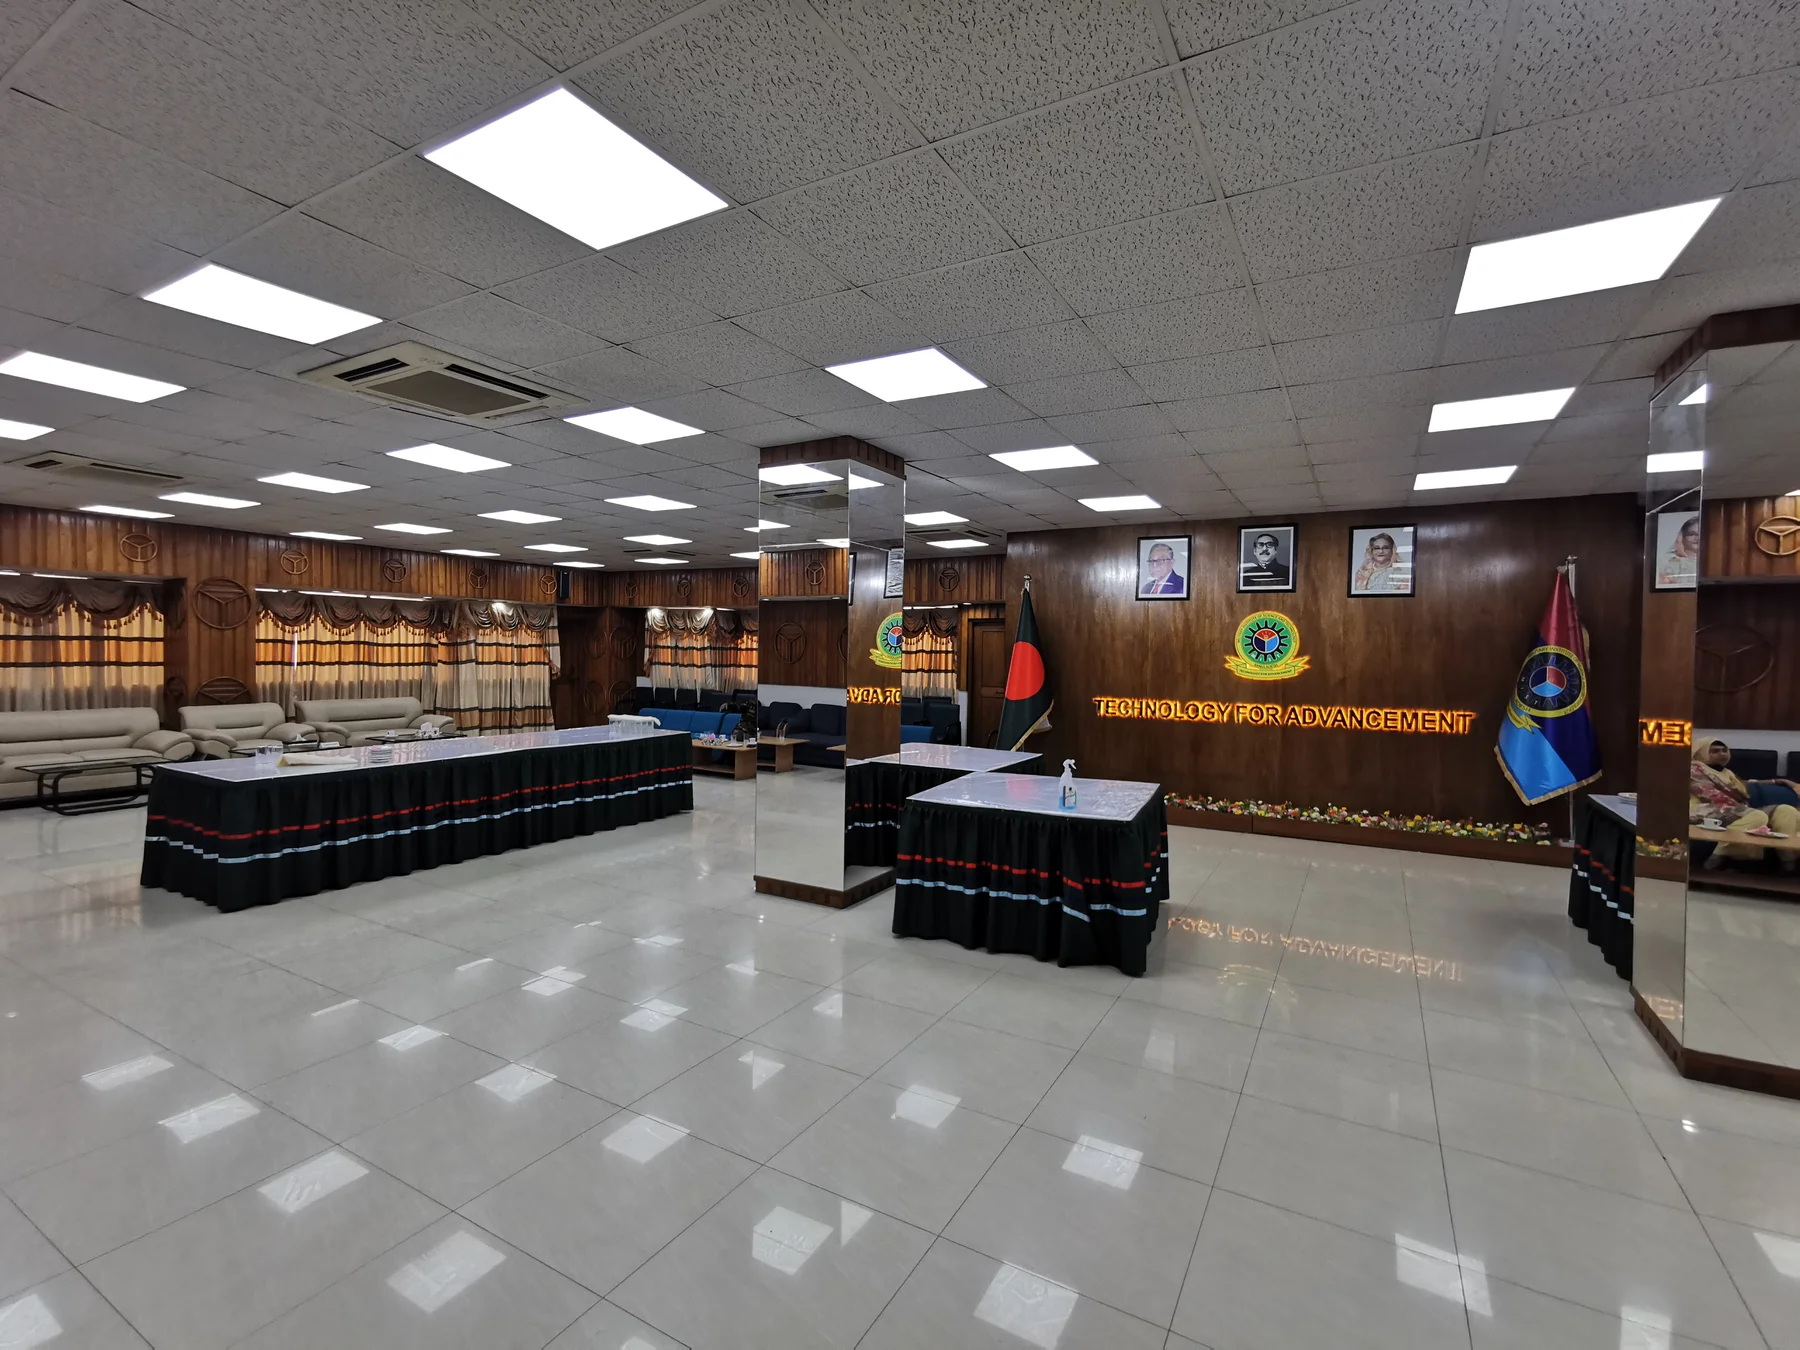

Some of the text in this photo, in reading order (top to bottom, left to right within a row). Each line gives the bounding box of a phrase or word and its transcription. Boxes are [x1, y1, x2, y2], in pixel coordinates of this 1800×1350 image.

[1093, 697, 1475, 734] TECHNOLOGY FOR ADVANCEMENT
